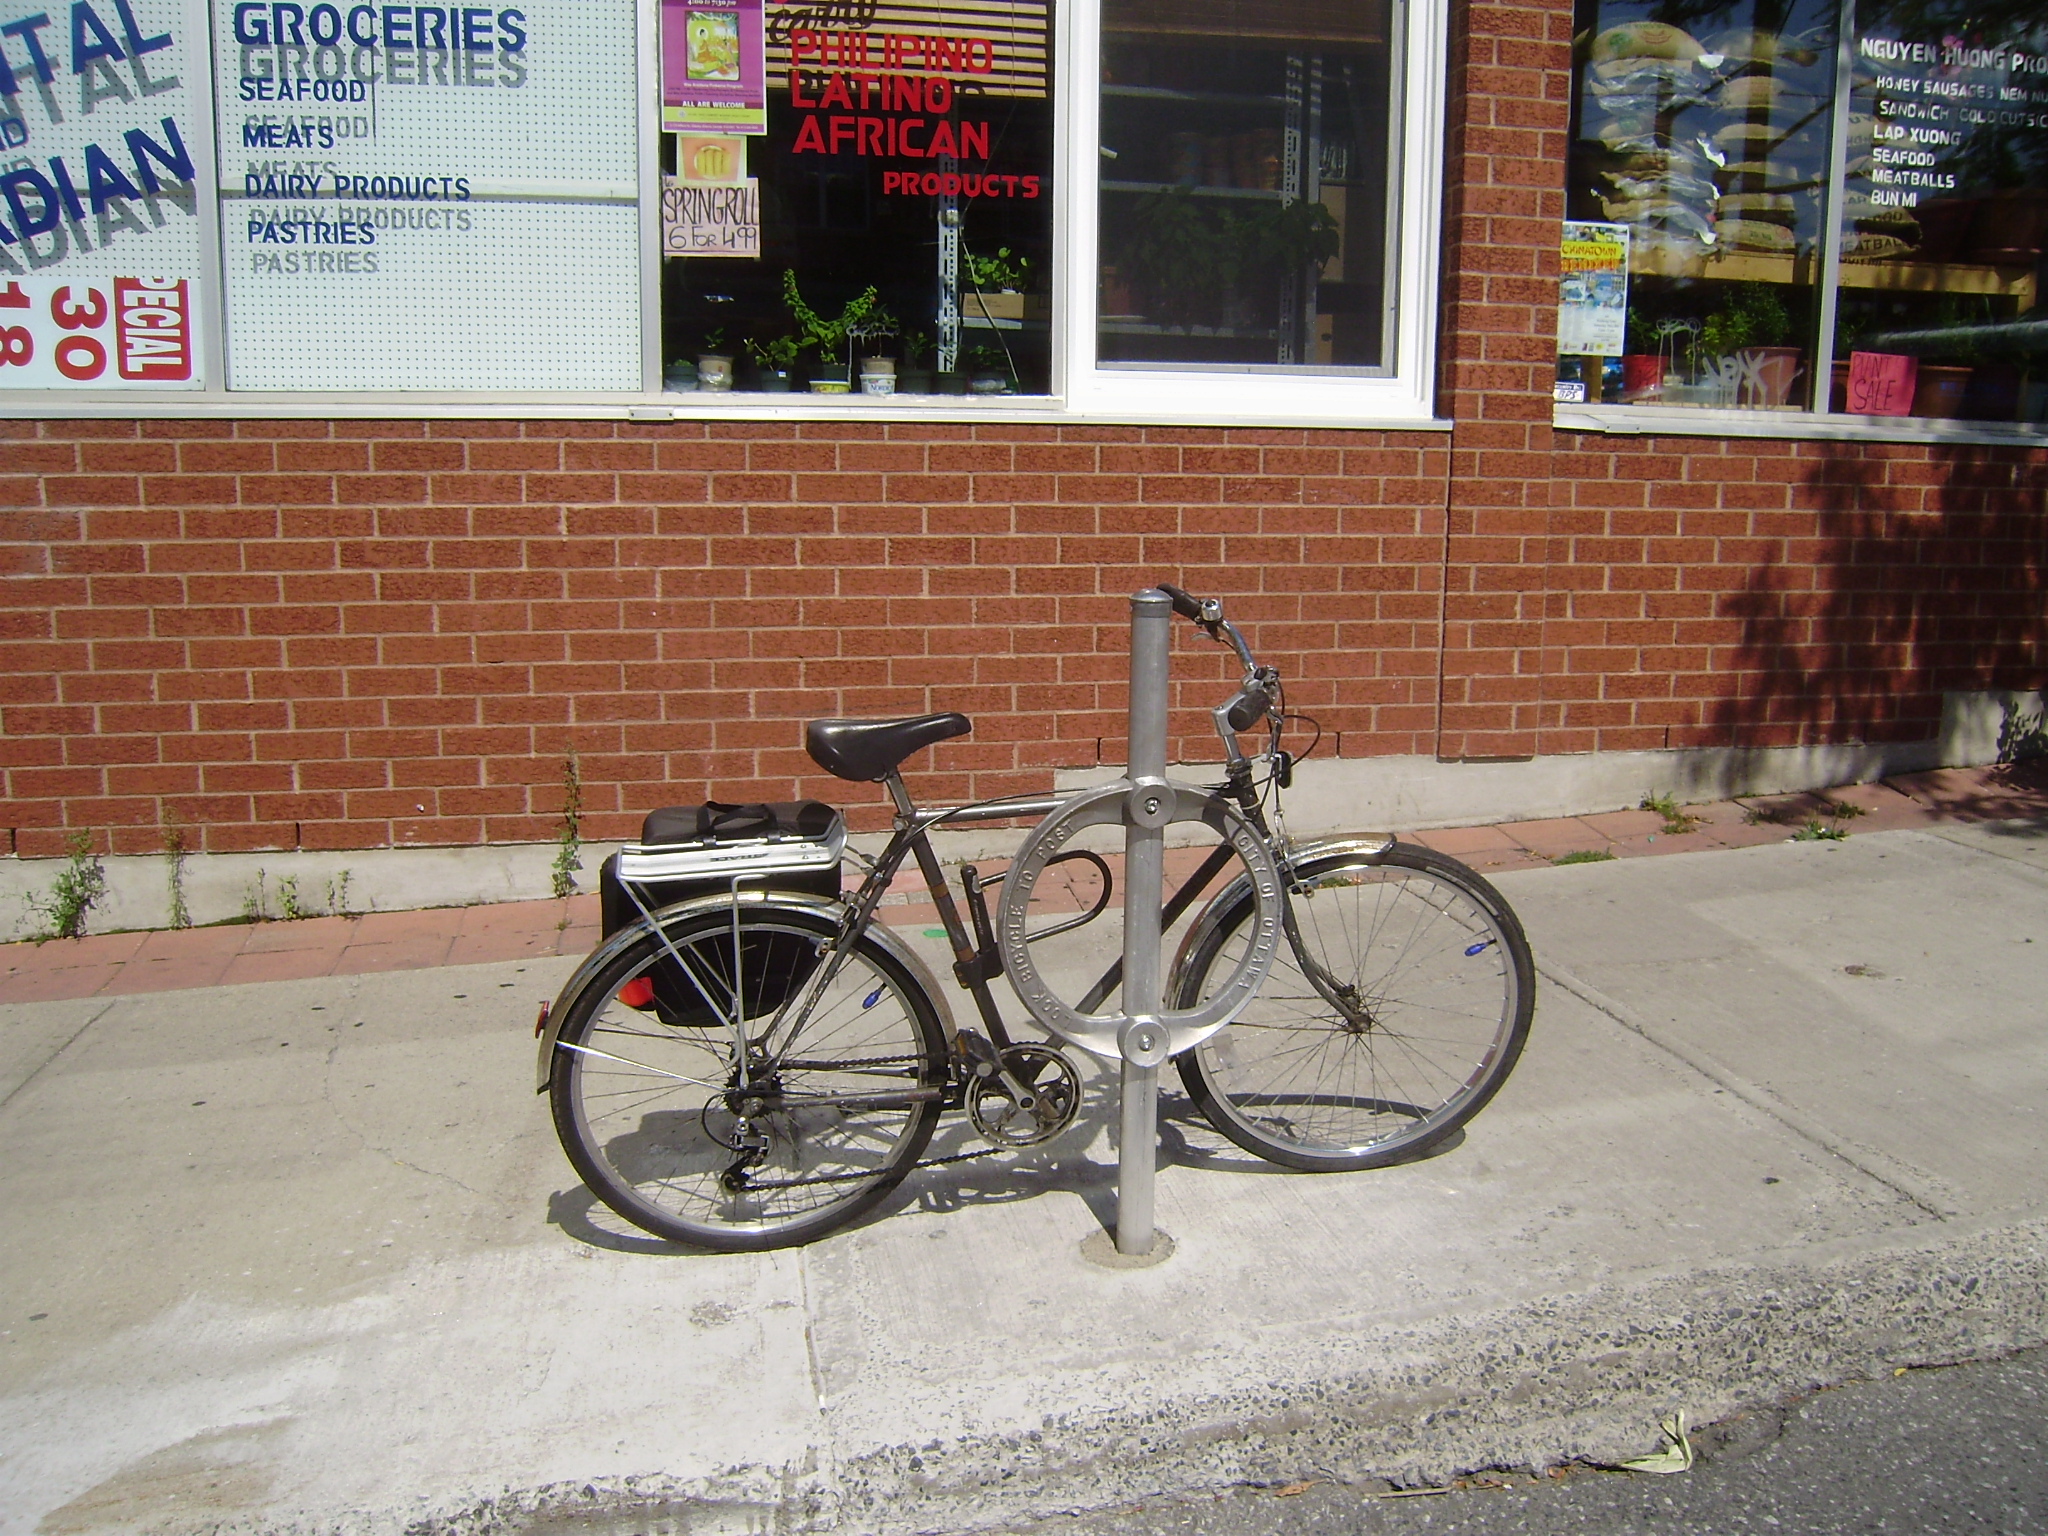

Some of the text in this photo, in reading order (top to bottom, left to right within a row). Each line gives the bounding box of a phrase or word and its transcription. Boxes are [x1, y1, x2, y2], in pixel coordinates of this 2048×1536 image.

[234, 2, 527, 51] GROCERIES
[790, 28, 994, 75] PHILIPINO
[1861, 38, 2048, 75] NGUYEN HUONG PRO
[239, 77, 366, 102] SEAFOOD
[791, 70, 953, 115] LATINO
[1876, 75, 1920, 93] HONEY
[1923, 80, 1995, 100] SAUSAGES
[2000, 86, 2027, 102] NEM
[682, 100, 695, 108] ALL
[712, 102, 746, 110] WELCOME
[1959, 107, 1996, 123] COLD
[242, 125, 335, 149] MEATS
[792, 115, 989, 160] AFRICAN
[1873, 124, 1962, 147] LAP XUONG
[1872, 148, 1936, 167] SEAFOOD
[245, 174, 471, 201] DAIRY PRODUCTS
[883, 171, 1040, 198] PRODUCTS
[1871, 169, 1956, 189] MEATBALLS
[1871, 189, 1917, 208] BUN MI
[248, 221, 375, 245] PASTRIES
[669, 225, 687, 249] 6
[1562, 244, 1617, 257] CHINATOWN
[50, 285, 108, 382] 30
[1851, 354, 1893, 379] PLANT
[1853, 379, 1897, 411] SALE
[1036, 821, 1076, 859] POST
[1018, 869, 1034, 892] TO
[1238, 835, 1275, 989] CITY OF OTTAWA
[1008, 904, 1033, 984] BICYCLE
